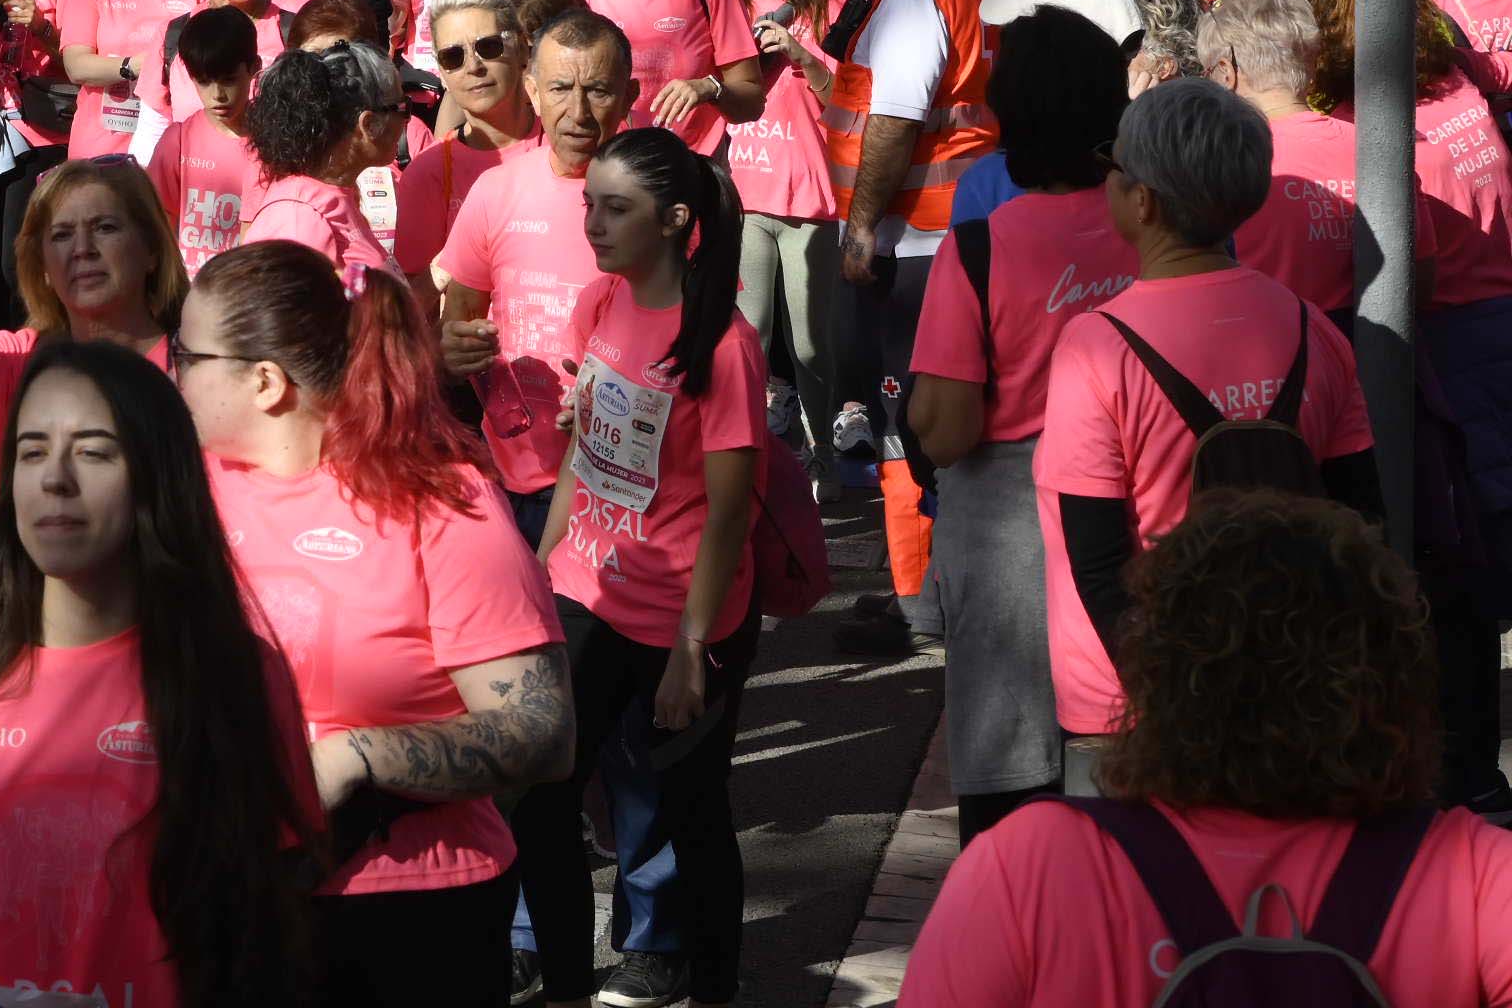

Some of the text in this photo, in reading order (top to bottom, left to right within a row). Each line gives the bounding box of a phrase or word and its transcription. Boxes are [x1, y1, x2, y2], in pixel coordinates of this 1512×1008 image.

[1425, 103, 1488, 146] CARRERA
[1447, 128, 1489, 160] DE LA
[1453, 145, 1501, 181] MUJER
[593, 416, 622, 445] 016
[592, 439, 615, 461] 12155
[606, 463, 629, 478] MUJER
[610, 482, 647, 503] Santander
